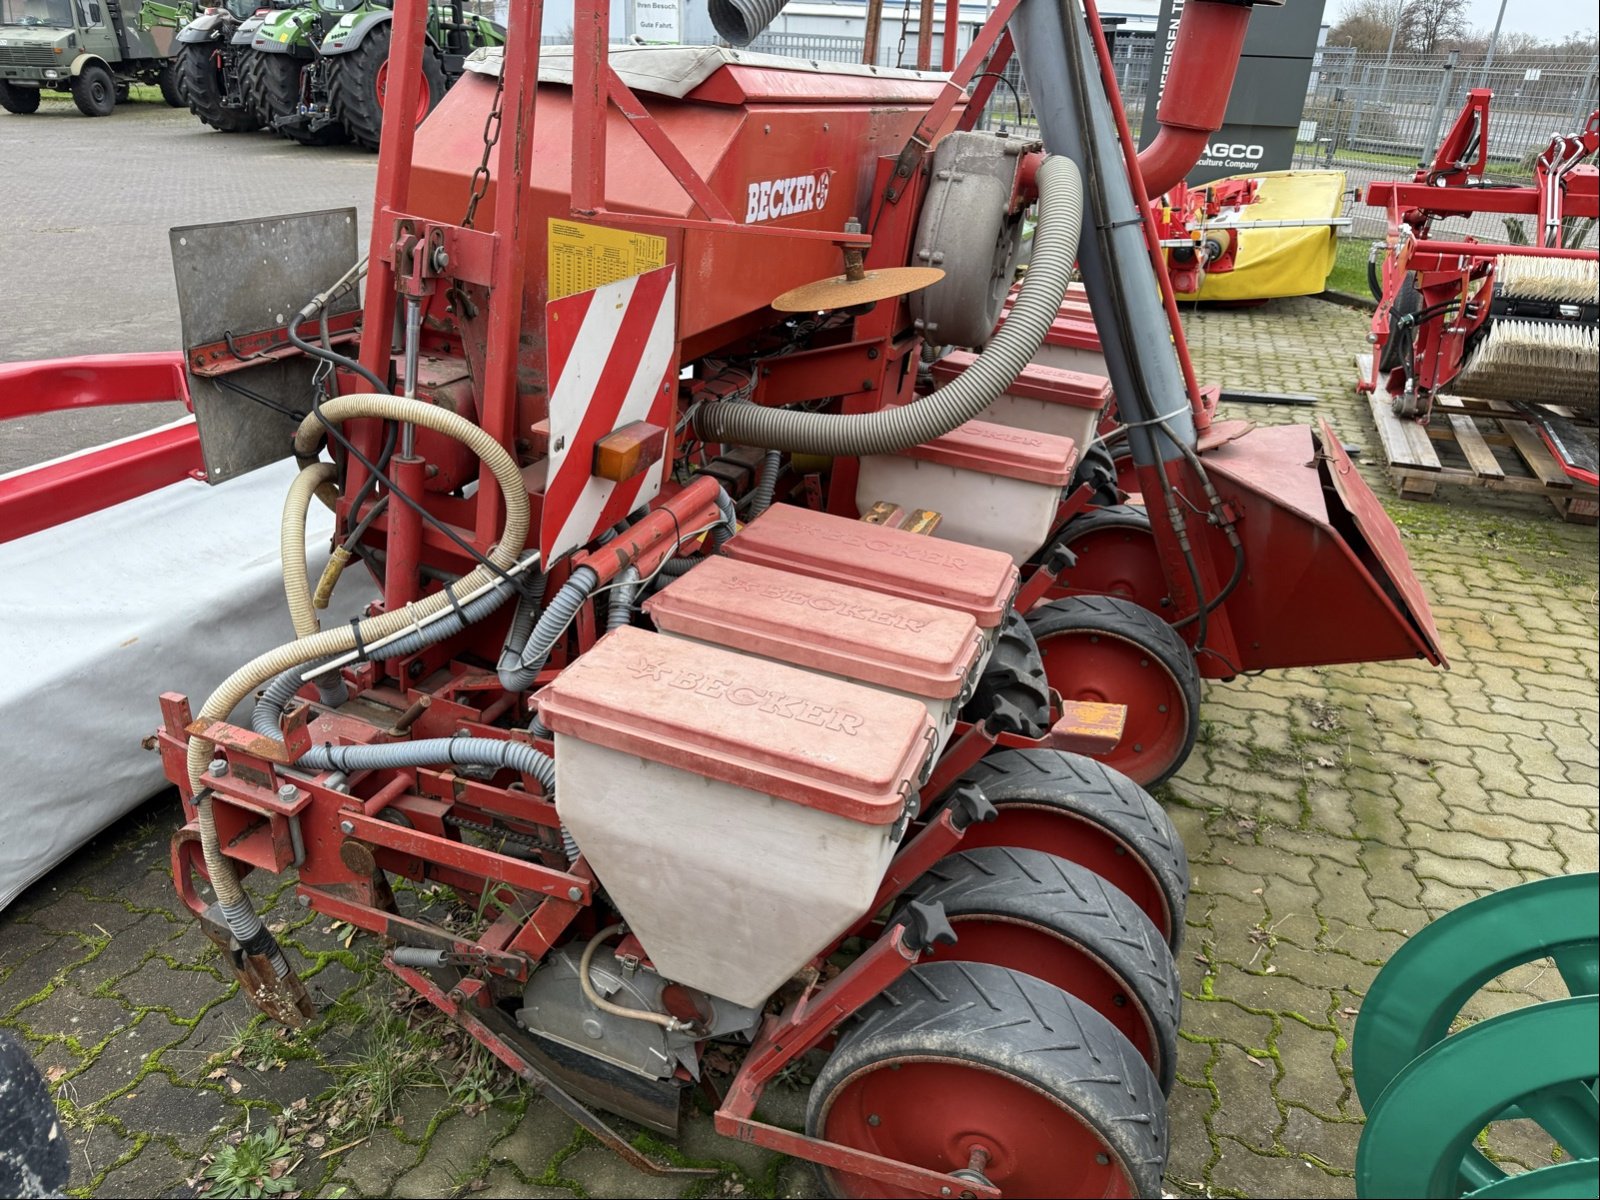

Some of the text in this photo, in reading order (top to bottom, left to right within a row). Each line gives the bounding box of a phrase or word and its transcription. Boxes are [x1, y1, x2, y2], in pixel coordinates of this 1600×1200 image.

[1202, 143, 1264, 159] AGCO
[1224, 160, 1259, 170] Company
[745, 175, 816, 224] BECKER
[959, 427, 1042, 447] CKER
[820, 529, 968, 571] BECKER
[760, 584, 929, 633] BECKER
[668, 669, 865, 736] BECKER
